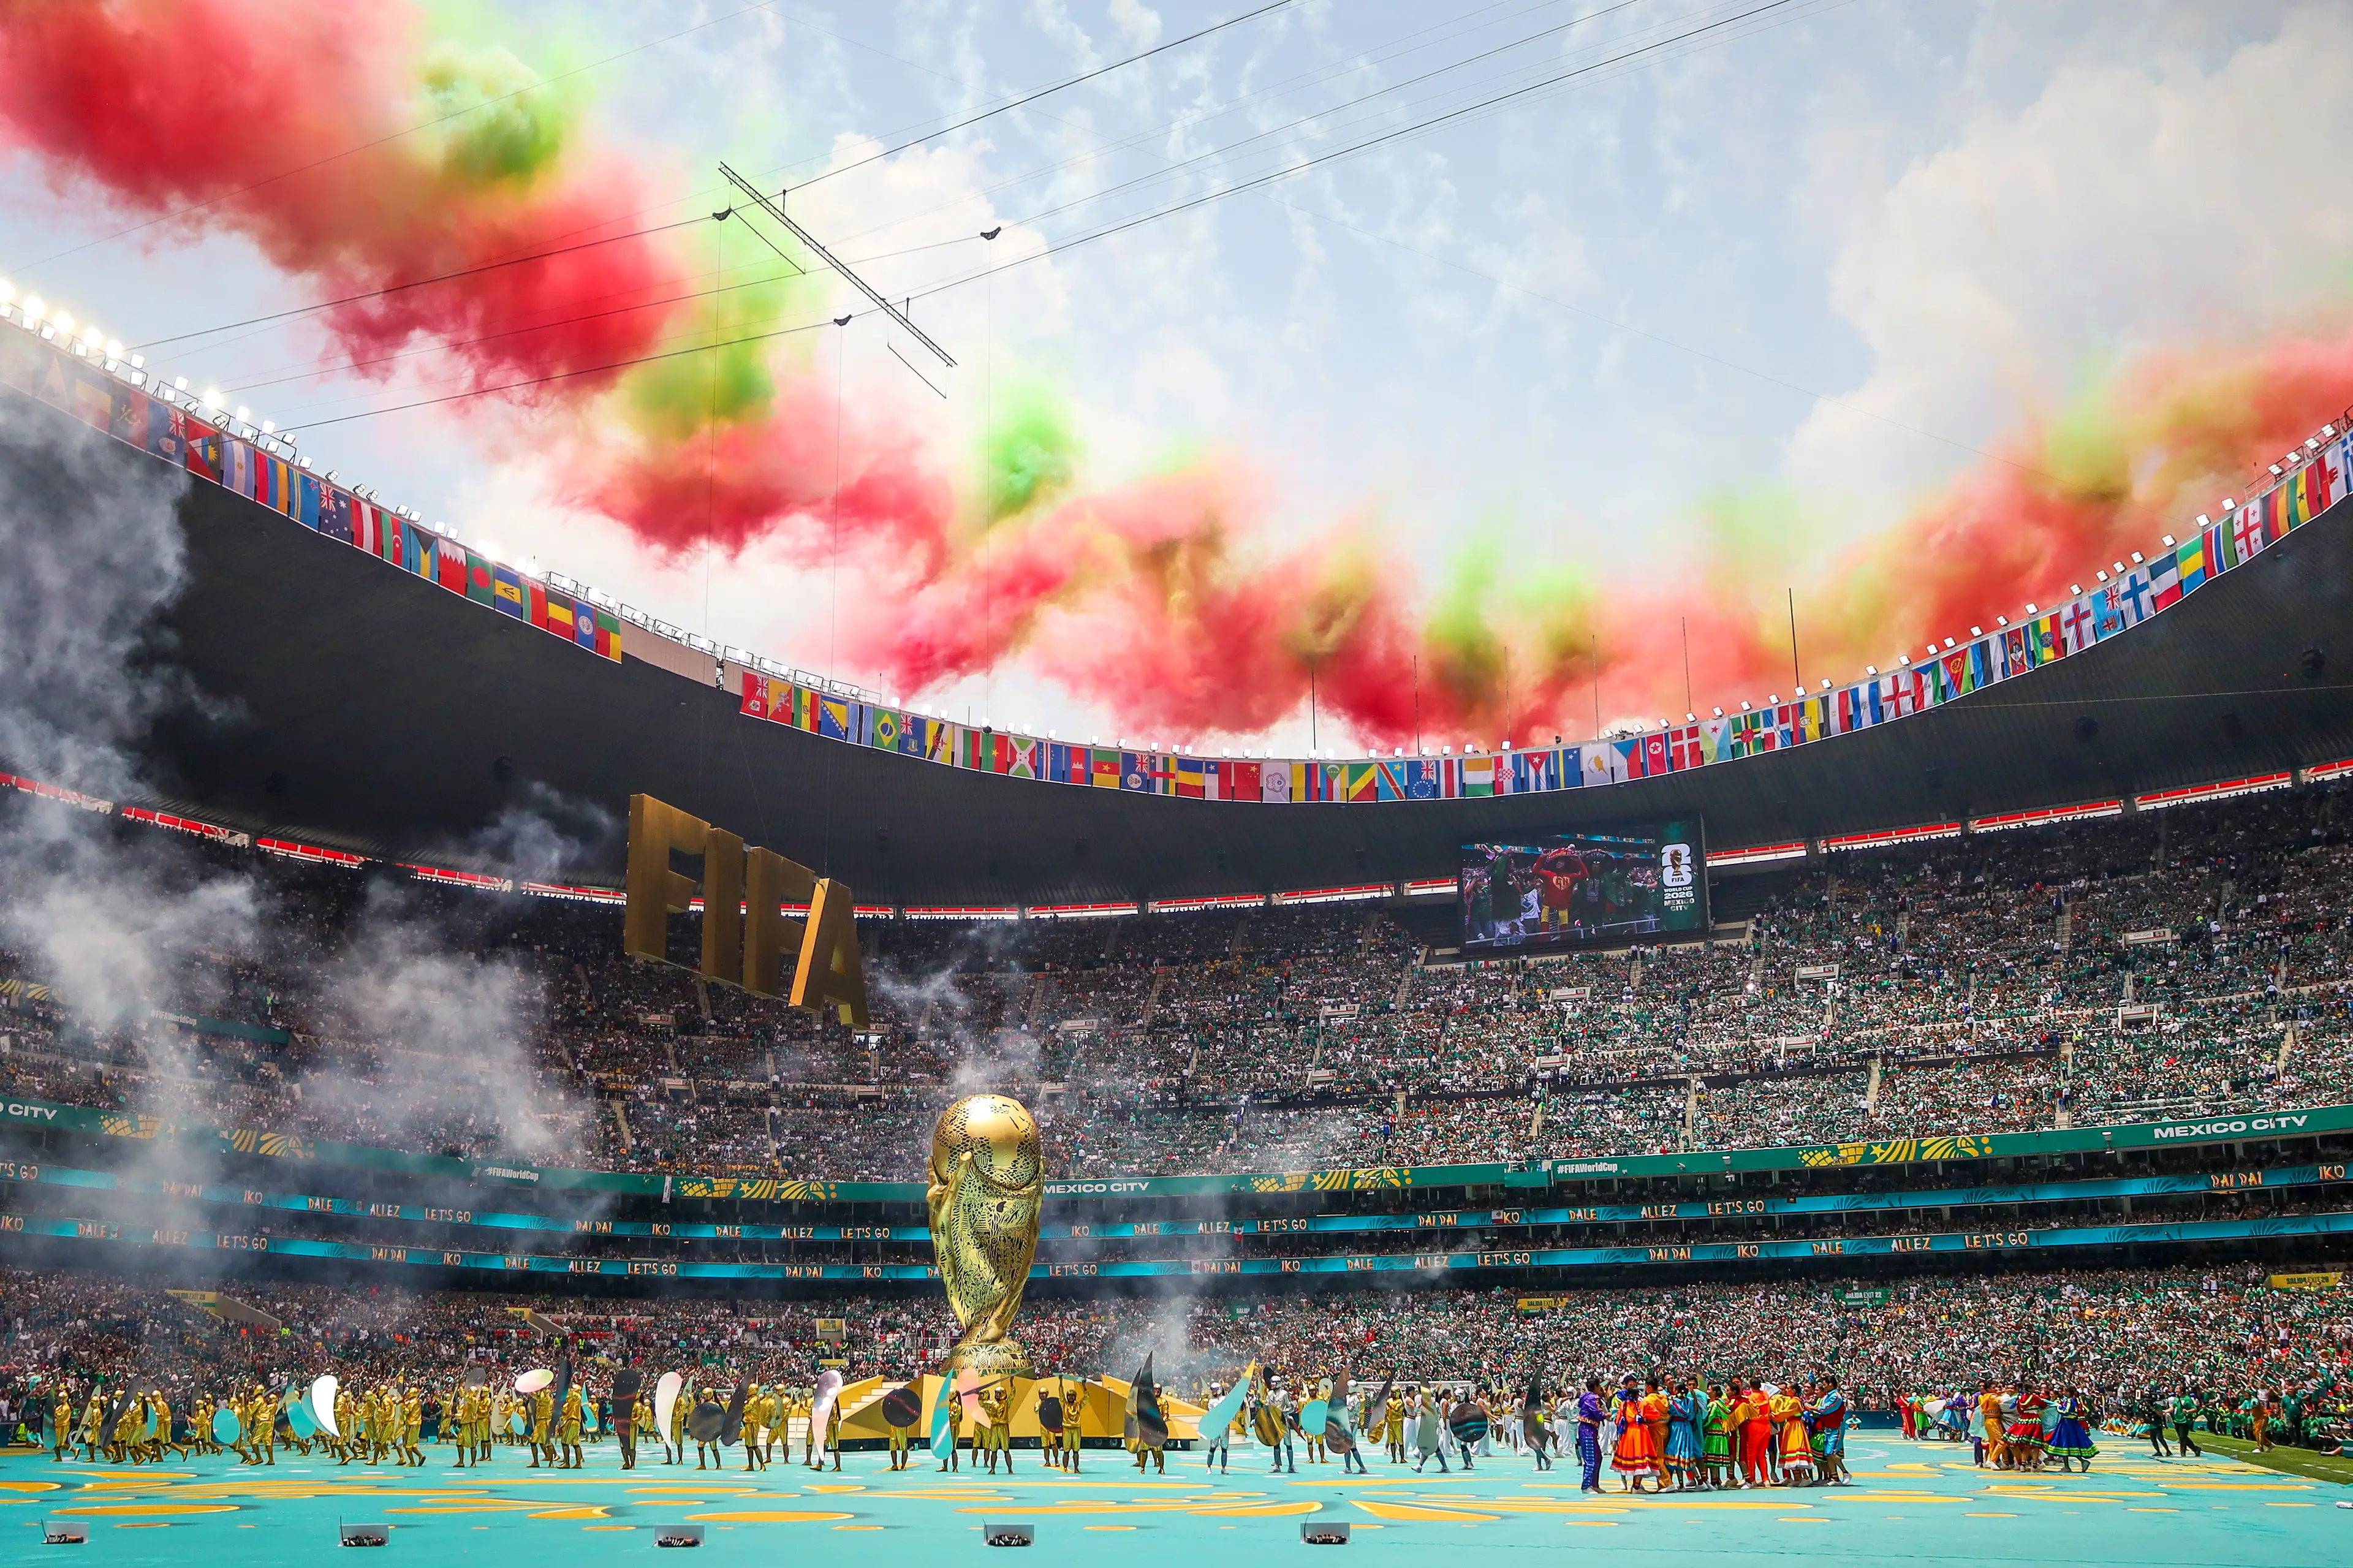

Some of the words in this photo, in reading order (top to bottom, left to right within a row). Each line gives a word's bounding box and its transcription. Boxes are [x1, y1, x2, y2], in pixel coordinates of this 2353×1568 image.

[1664, 891, 1694, 900] 2026
[1664, 898, 1695, 906] MEXICO
[624, 793, 870, 1030] FIFA
[8, 1104, 58, 1120] CITY
[2154, 1121, 2246, 1138] MEXICO
[2251, 1115, 2308, 1131] CITY
[20, 1165, 38, 1180] GO
[485, 1168, 539, 1182] #FIFAWorldCup
[1557, 1162, 1618, 1174] #FIFAWorldCup
[2319, 1165, 2346, 1180] IKO
[2211, 1173, 2235, 1187] DAI
[2238, 1171, 2262, 1186] DAI
[1043, 1183, 1107, 1194] MEXICO
[1110, 1181, 1150, 1192] CITY
[244, 1190, 263, 1205] IKO
[308, 1197, 333, 1211] DALE
[369, 1203, 400, 1218] ALLEZ
[1569, 1208, 1597, 1221] DALE
[1641, 1205, 1677, 1219] ALLEZ
[1707, 1200, 1742, 1215] LET'S
[1746, 1200, 1765, 1213] GO
[425, 1208, 453, 1222] LET'S
[457, 1211, 471, 1223] GO
[1419, 1215, 1436, 1227] DAI
[1439, 1213, 1457, 1225] DAI
[1503, 1211, 1520, 1224] KO
[1, 1215, 24, 1232] IKO
[576, 1220, 593, 1232] DAI
[596, 1221, 612, 1233] DAI
[651, 1223, 670, 1235] IKO
[1134, 1224, 1159, 1236] DALE
[1198, 1221, 1230, 1234] ALLEZ
[1258, 1219, 1287, 1232] LET'S
[1291, 1218, 1307, 1230] GO
[78, 1224, 106, 1238] DALE
[716, 1225, 741, 1237] DALE
[781, 1227, 814, 1239] ALLEZ
[841, 1226, 871, 1239] LET'S
[874, 1227, 890, 1239] GO
[1071, 1225, 1090, 1237] IKO
[216, 1233, 248, 1249] LET'S
[251, 1237, 268, 1251] GO
[1891, 1237, 1931, 1252] ALLEZ
[1965, 1233, 2004, 1248] LET'S
[2008, 1232, 2028, 1246] GO
[372, 1248, 387, 1261] DAI
[391, 1249, 406, 1262] DAI
[1649, 1248, 1668, 1261] DAI
[1672, 1246, 1691, 1260] DAI
[1737, 1244, 1759, 1258] IKO
[1813, 1241, 1844, 1256] DALE
[444, 1252, 461, 1266] IKO
[505, 1257, 529, 1270] DALE
[1281, 1260, 1300, 1272] IKO
[1347, 1258, 1374, 1271] DALE
[1414, 1256, 1449, 1269] ALLEZ
[1477, 1253, 1509, 1267] LET'S
[1514, 1252, 1530, 1265] GO
[568, 1260, 601, 1273] ALLEZ
[627, 1262, 657, 1275] LET'S
[661, 1263, 677, 1275] GO
[786, 1266, 802, 1278] DAI
[806, 1266, 823, 1278] DAI
[863, 1266, 882, 1278] IKO
[1049, 1263, 1078, 1277] LET'S
[1082, 1263, 1097, 1276] GO
[1203, 1262, 1220, 1274] DAI
[1224, 1261, 1241, 1273] DAI
